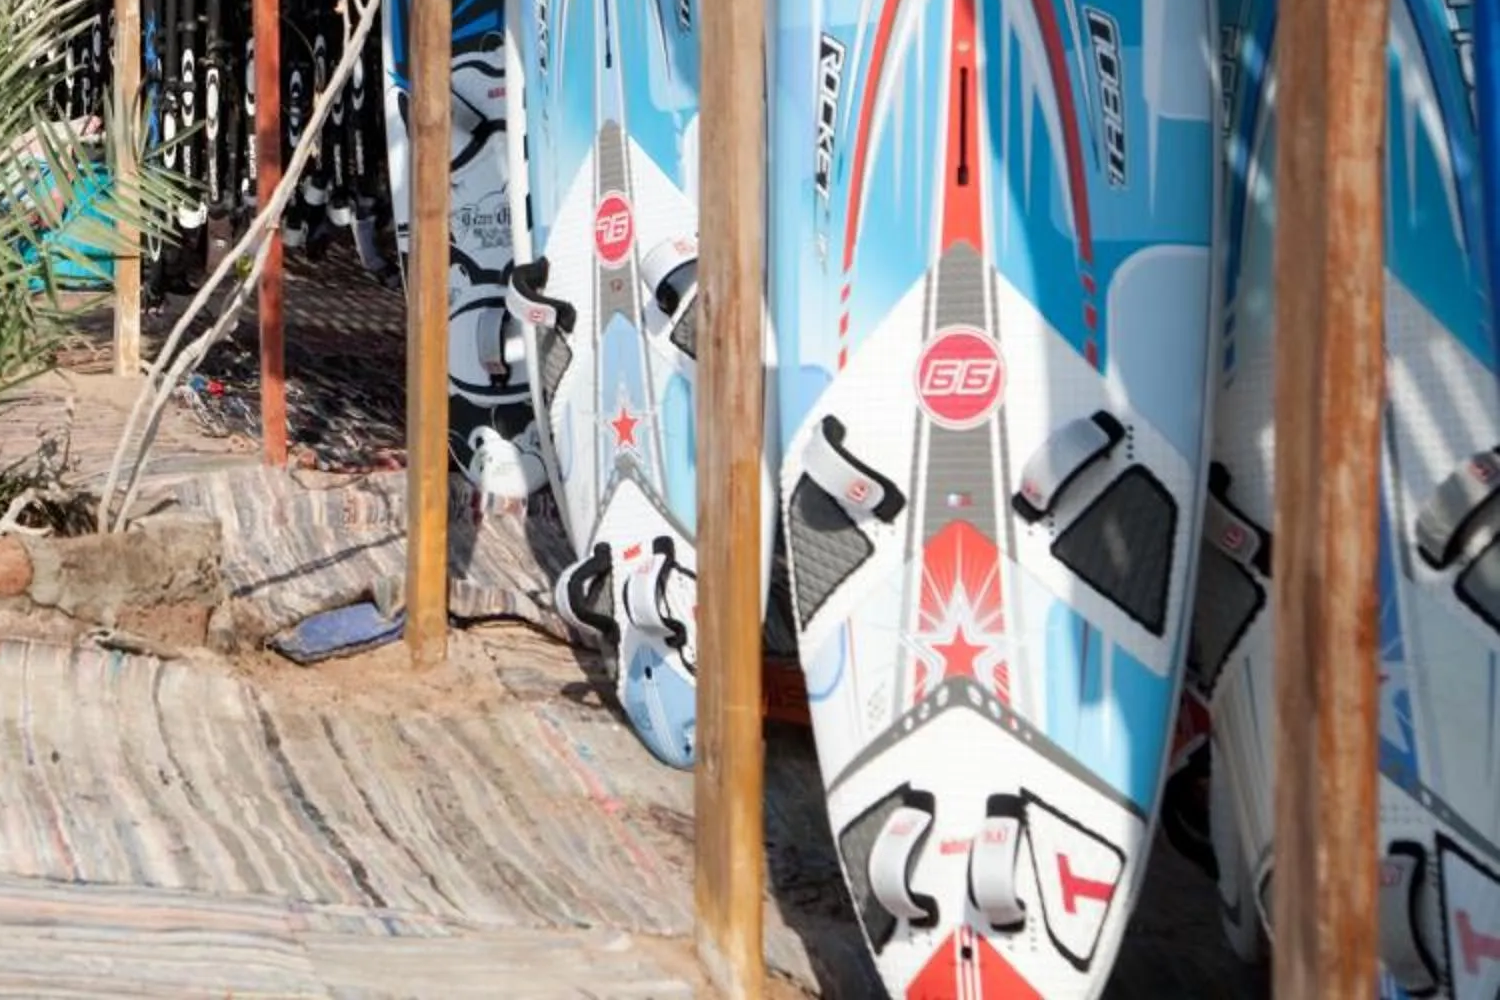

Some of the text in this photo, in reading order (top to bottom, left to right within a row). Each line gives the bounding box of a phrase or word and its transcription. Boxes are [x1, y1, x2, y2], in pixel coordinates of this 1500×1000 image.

[815, 33, 847, 201] ROCKET
[1086, 8, 1126, 188] TABOU
[921, 358, 999, 396] 66
